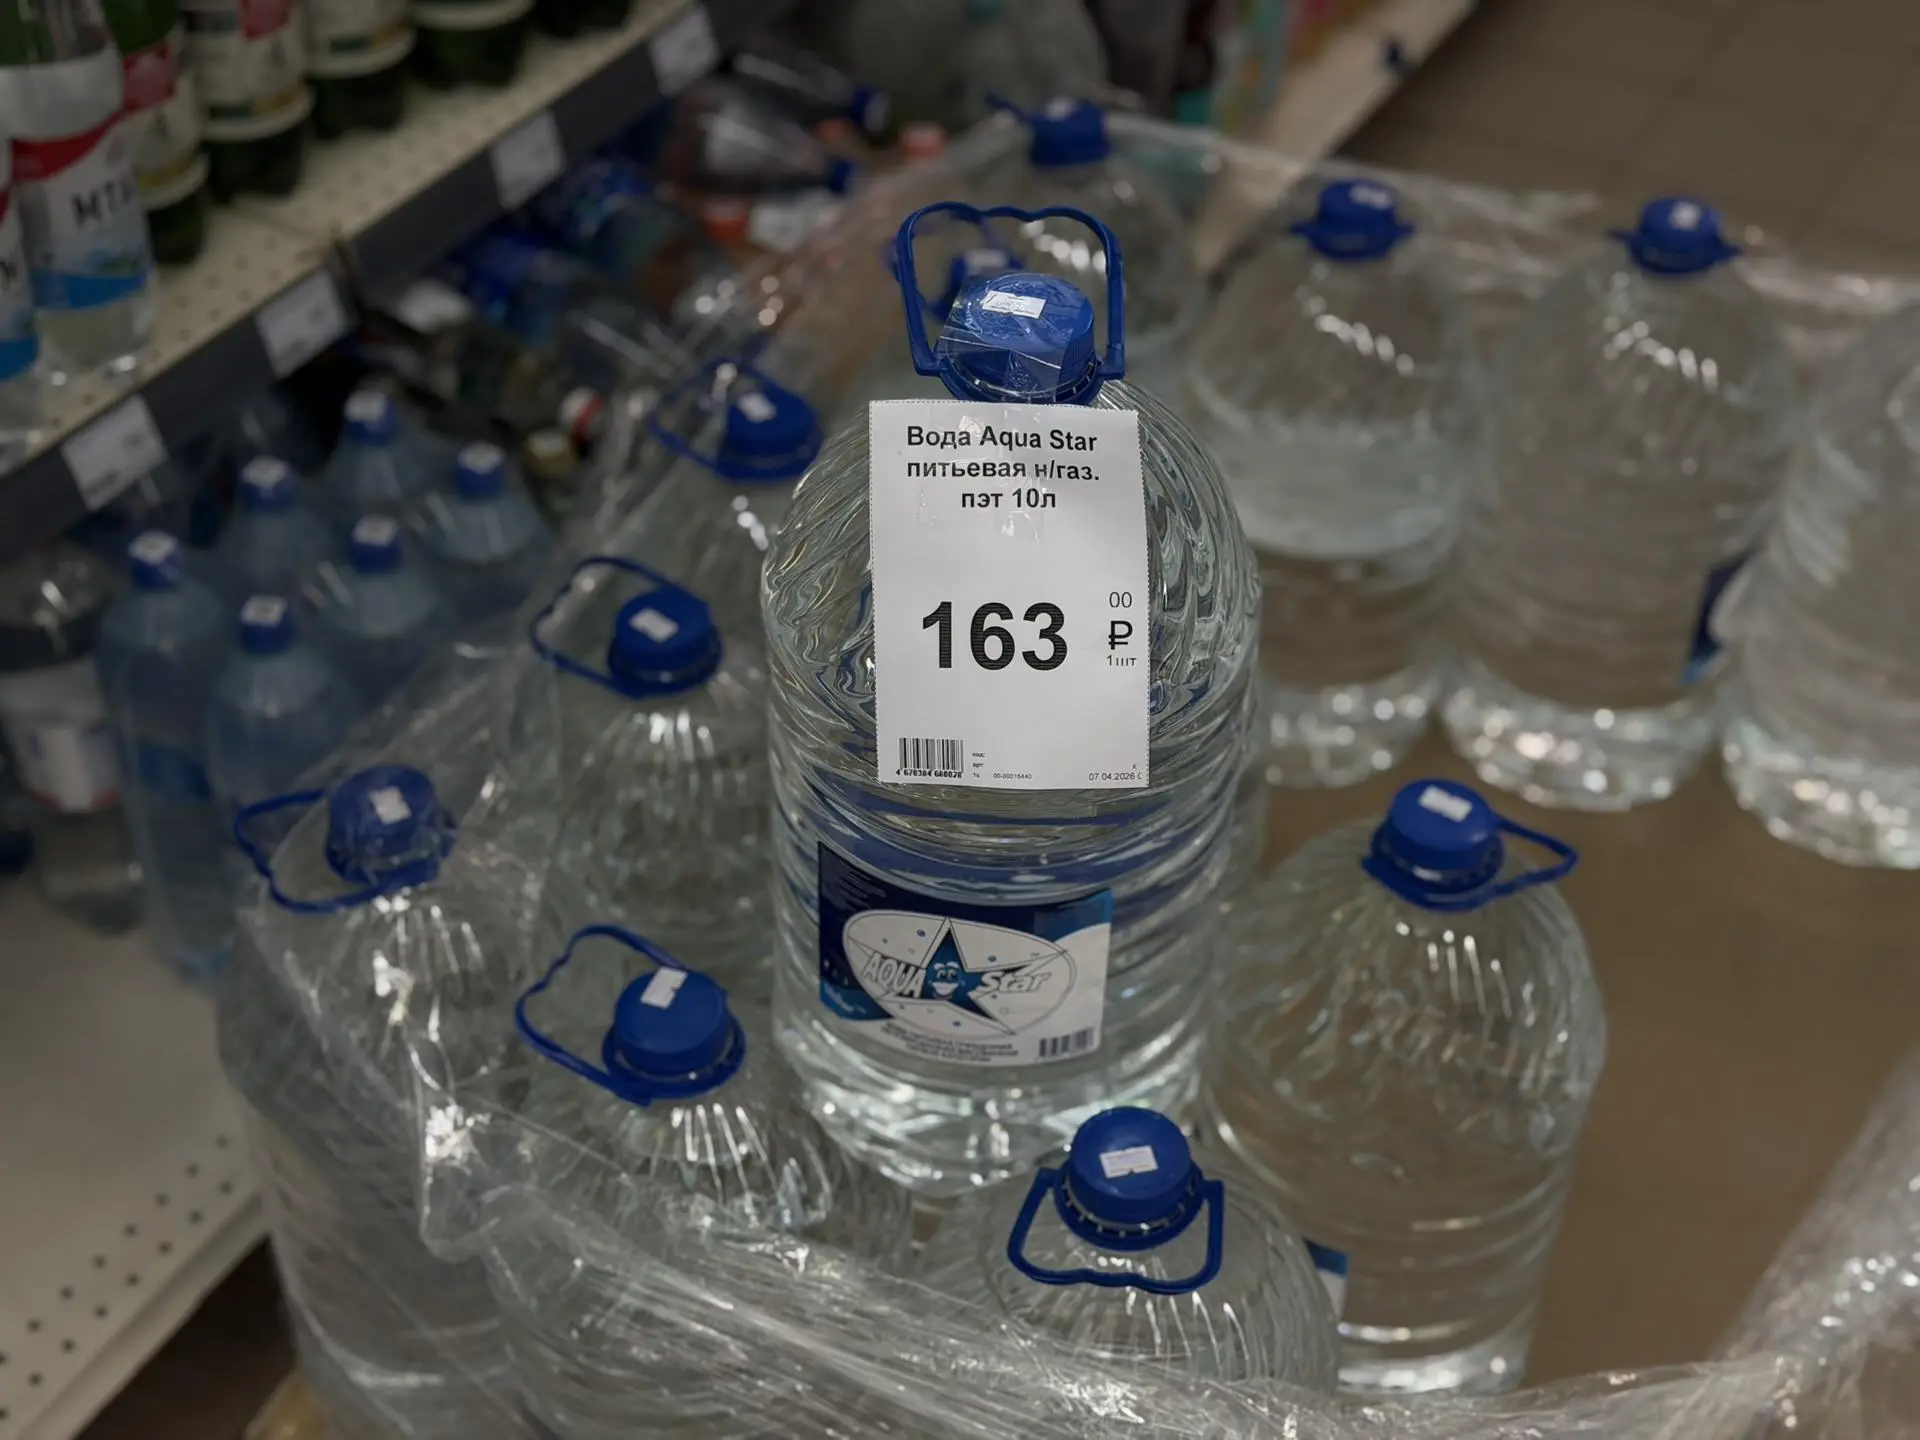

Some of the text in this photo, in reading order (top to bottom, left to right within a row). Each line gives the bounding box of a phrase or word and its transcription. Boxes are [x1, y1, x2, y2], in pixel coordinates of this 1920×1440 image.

[907, 425, 1098, 451] Вода Aqua Star
[907, 460, 1100, 481] питьевая н/газ.
[961, 489, 1057, 509] пэт 10л
[1109, 592, 1132, 609] 00
[922, 600, 1069, 672] 163
[861, 950, 927, 999] AQUA
[974, 970, 1052, 994] Star
